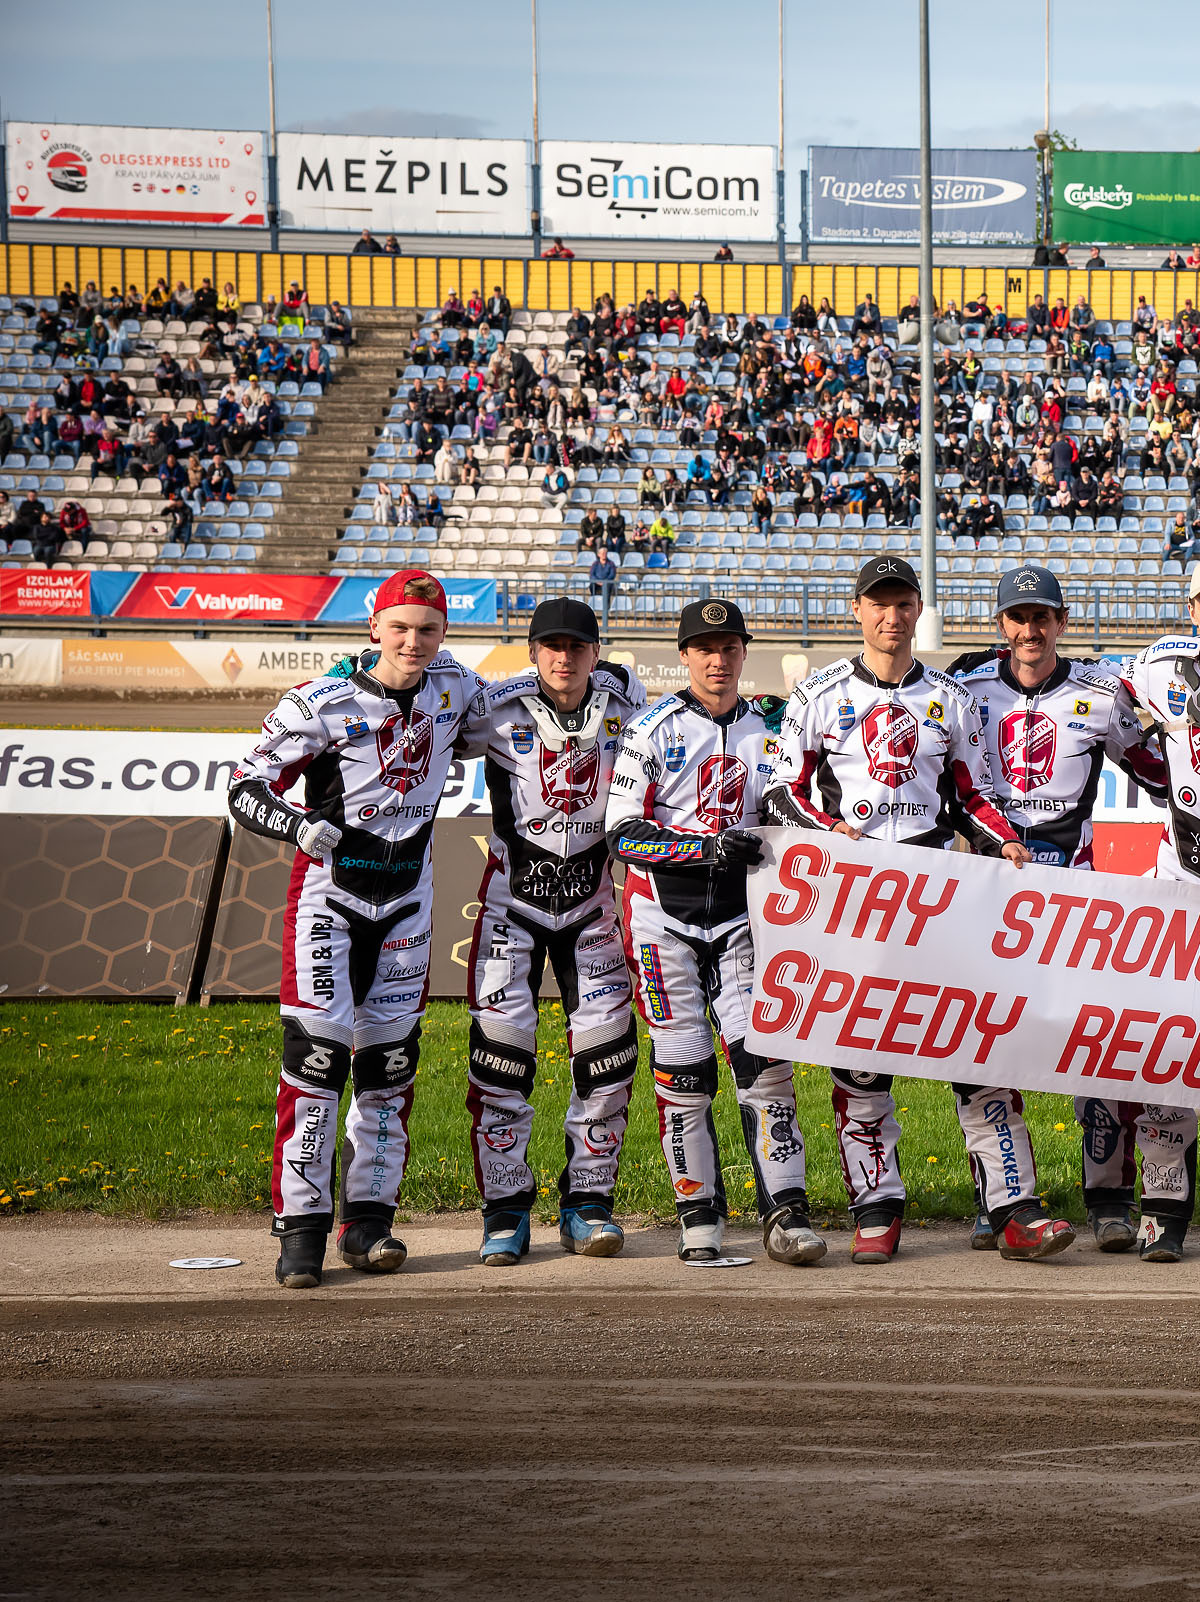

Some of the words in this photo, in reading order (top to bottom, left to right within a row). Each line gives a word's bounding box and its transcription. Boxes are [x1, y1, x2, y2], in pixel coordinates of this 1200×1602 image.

[100, 153, 203, 168] OLEGSEXPRESS
[207, 157, 230, 169] LTD
[115, 170, 147, 180] KRAVU
[297, 149, 508, 197] MEŽPILS
[556, 163, 760, 202] SemiCom
[819, 175, 906, 204] Tapetes
[914, 180, 985, 201] vsiem
[1064, 183, 1132, 210] Carlsberg
[1136, 193, 1173, 203] Probably
[1174, 193, 1188, 203] the
[662, 205, 760, 218] www.semicom.lv
[821, 227, 860, 237] Stadiona
[1008, 277, 1022, 293] M
[26, 575, 74, 587] IZCILAM
[17, 587, 84, 600] REMONTAM
[195, 593, 285, 611] Valvoline
[1152, 641, 1198, 653] TRODO
[96, 650, 124, 662] SAVU
[258, 652, 324, 670] AMBER
[637, 664, 654, 676] Dr.
[307, 681, 349, 704] TRODO
[490, 681, 536, 702] TRODO
[638, 696, 677, 728] TRODO
[382, 804, 435, 819] OPTIBET
[878, 802, 929, 816] OPTIBET
[1010, 799, 1067, 812] OPTIBET
[552, 821, 605, 835] OPTIBET
[678, 842, 699, 854] LES
[533, 882, 584, 897] BEAR
[762, 844, 959, 947] STAY
[311, 914, 334, 942] VBJ
[312, 945, 332, 960] &
[313, 965, 334, 1000] JBM
[369, 990, 421, 1004] TRODO
[582, 982, 628, 1002] TRODO
[752, 950, 1028, 1065] SPEEDY
[472, 1049, 526, 1077] ALPROMO
[589, 1043, 638, 1076] ALPROMO
[300, 1065, 327, 1079] Systems
[672, 1143, 688, 1175] AMBER
[995, 1123, 1022, 1199] STOKKER
[488, 1161, 528, 1175] YOGGI
[491, 1176, 521, 1187] BEAR
